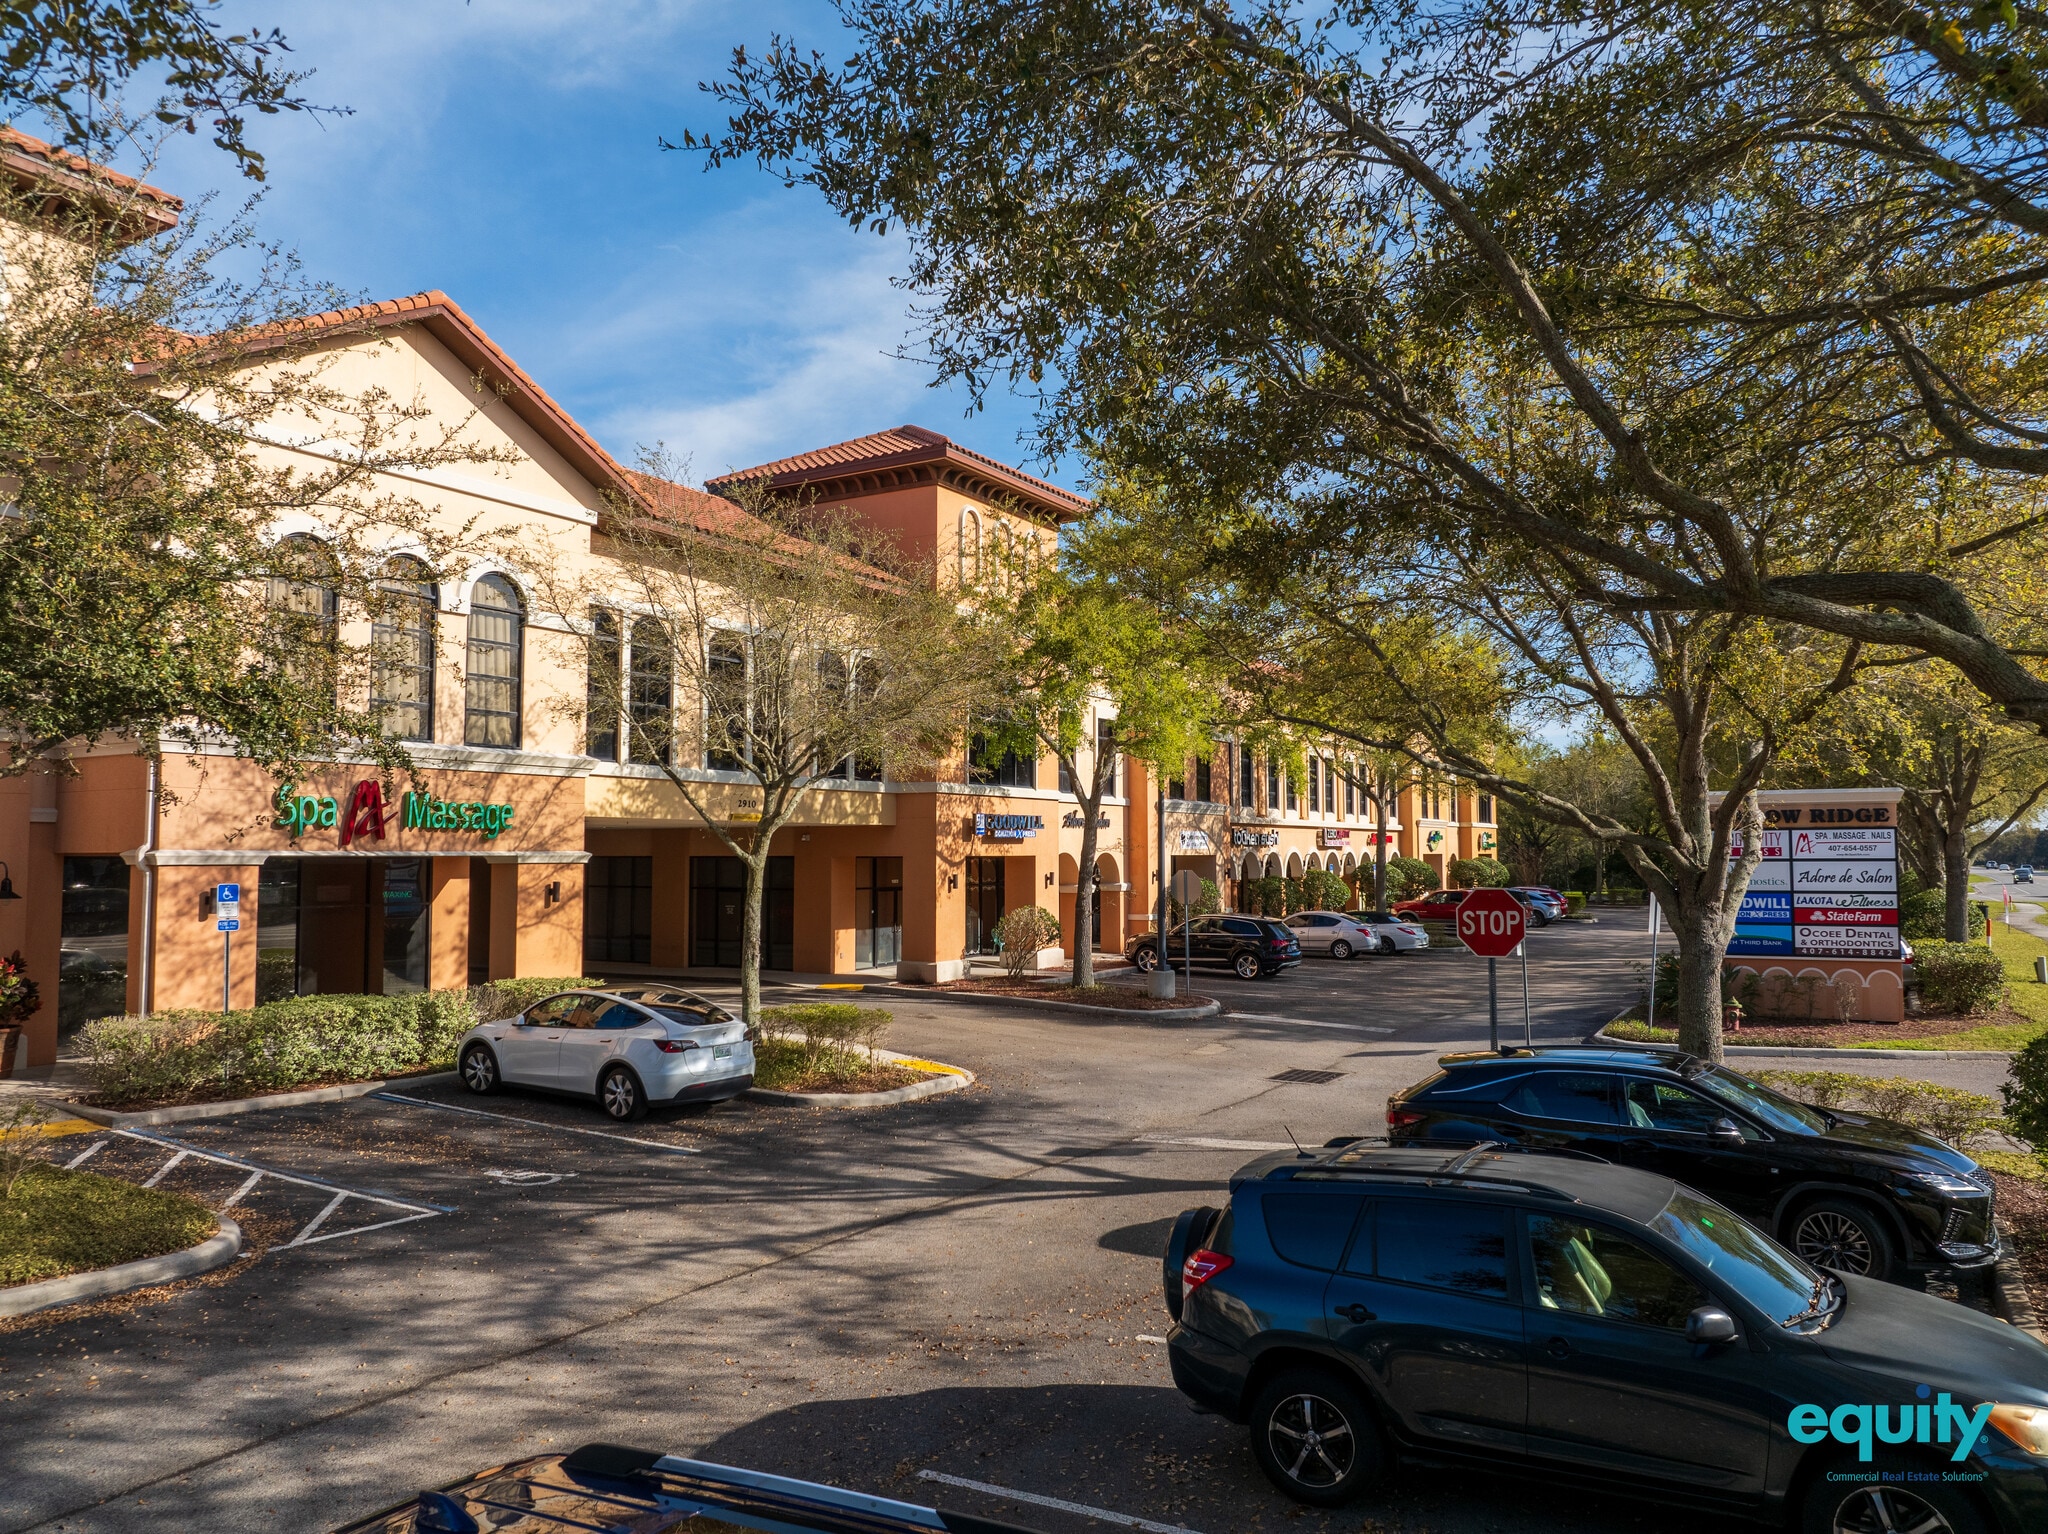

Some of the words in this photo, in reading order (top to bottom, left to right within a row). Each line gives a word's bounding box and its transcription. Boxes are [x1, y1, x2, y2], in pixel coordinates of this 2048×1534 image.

[738, 800, 757, 808] 2910
[279, 784, 338, 837] Spa
[404, 792, 514, 839] Massage
[1809, 807, 1890, 823] RIDGE
[986, 814, 1045, 829] GOODWILL
[1871, 831, 1891, 839] NAILS
[1798, 868, 1836, 883] Adore
[1839, 868, 1852, 883] de
[1856, 868, 1893, 883] Salon
[383, 890, 412, 898] WAXING
[1796, 896, 1833, 905] LAKOTA
[1835, 895, 1894, 907] Wellness
[1461, 910, 1520, 935] STOP
[1800, 927, 1842, 938] OCOEE
[1845, 928, 1894, 939] DENTAL
[1810, 939, 1894, 947] ORTHODONTICS
